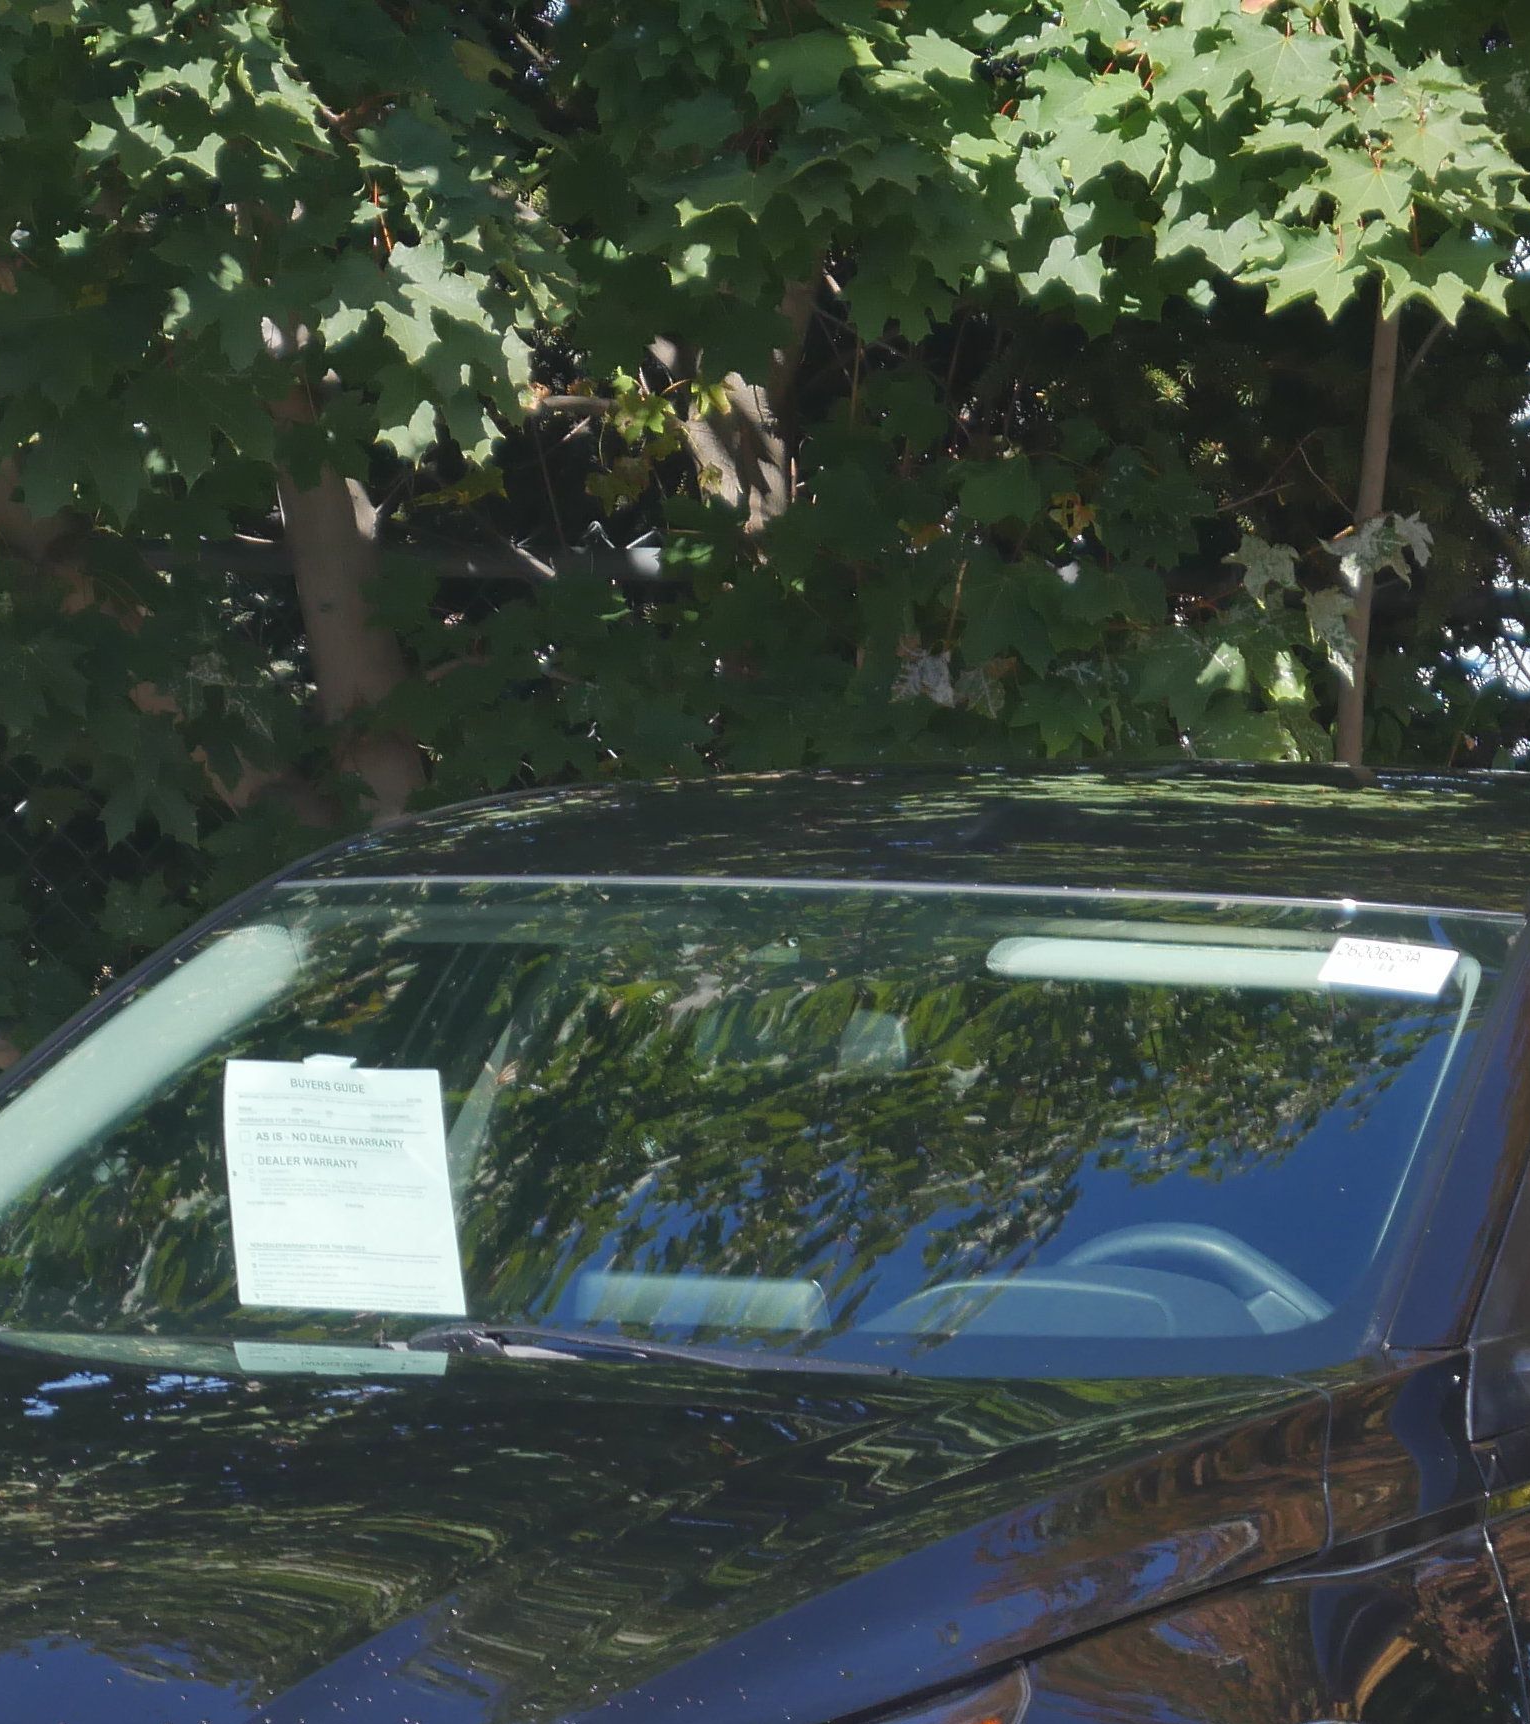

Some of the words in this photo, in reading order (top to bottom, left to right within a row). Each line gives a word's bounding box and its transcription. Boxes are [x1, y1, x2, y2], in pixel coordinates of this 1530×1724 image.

[289, 1077, 332, 1091] BUYERS
[333, 1081, 366, 1095] GUIDE
[255, 1131, 270, 1141] AS
[272, 1131, 283, 1142] IS
[292, 1131, 308, 1142] NO
[309, 1132, 348, 1145] DEALER
[349, 1135, 405, 1149] WARRANTY
[257, 1155, 301, 1166] DEALER
[303, 1157, 358, 1169] WARRANTY
